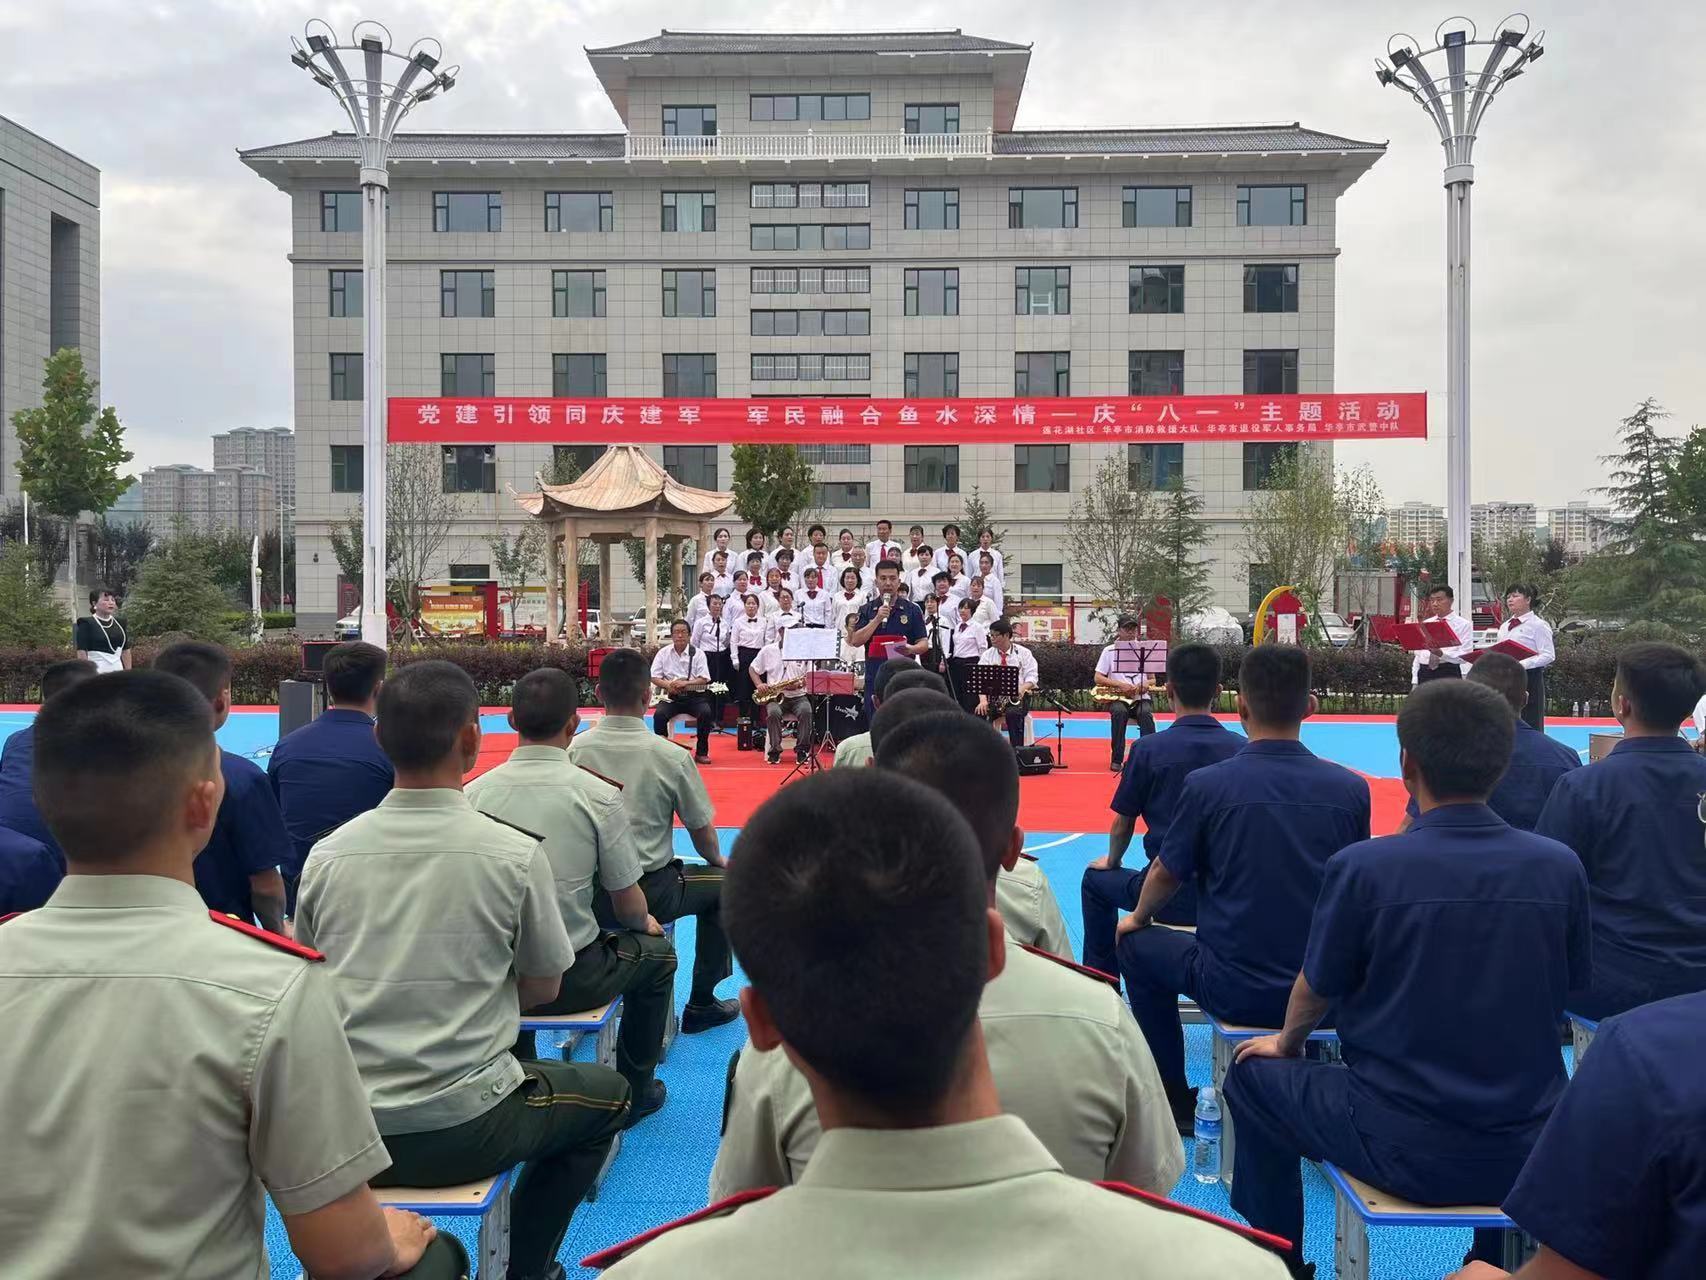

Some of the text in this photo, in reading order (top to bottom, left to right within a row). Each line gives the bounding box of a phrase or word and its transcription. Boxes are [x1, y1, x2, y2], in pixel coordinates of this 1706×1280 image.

[417, 404, 701, 426] 党建引领同庆建军
[1102, 424, 1200, 435] 华亭市消防救援大队
[1207, 423, 1318, 434] 华亭市退役军人事务局
[1324, 421, 1400, 433] 华亭市武警中队
